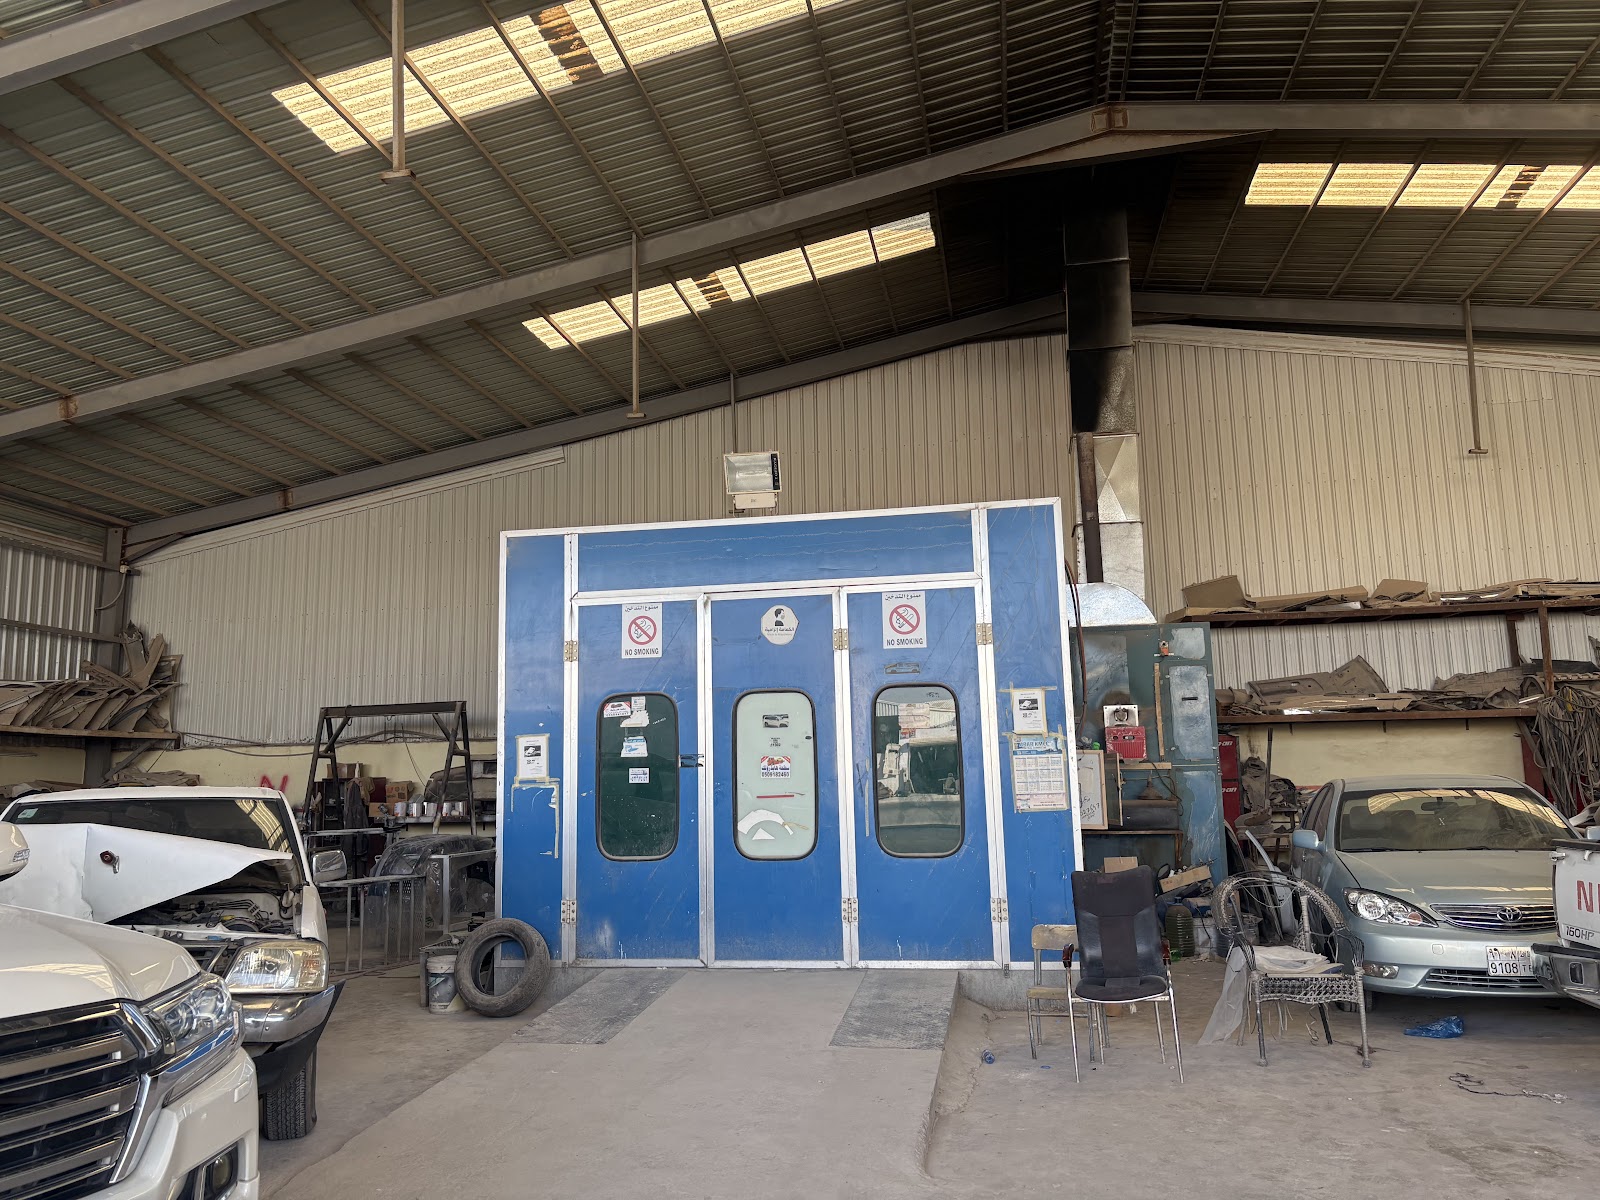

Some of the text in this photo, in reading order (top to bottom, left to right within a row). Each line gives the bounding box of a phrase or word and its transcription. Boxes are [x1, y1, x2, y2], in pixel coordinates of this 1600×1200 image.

[896, 637, 924, 646] SMOKING
[634, 647, 659, 655] SMOKING
[1490, 962, 1519, 974] 9108
